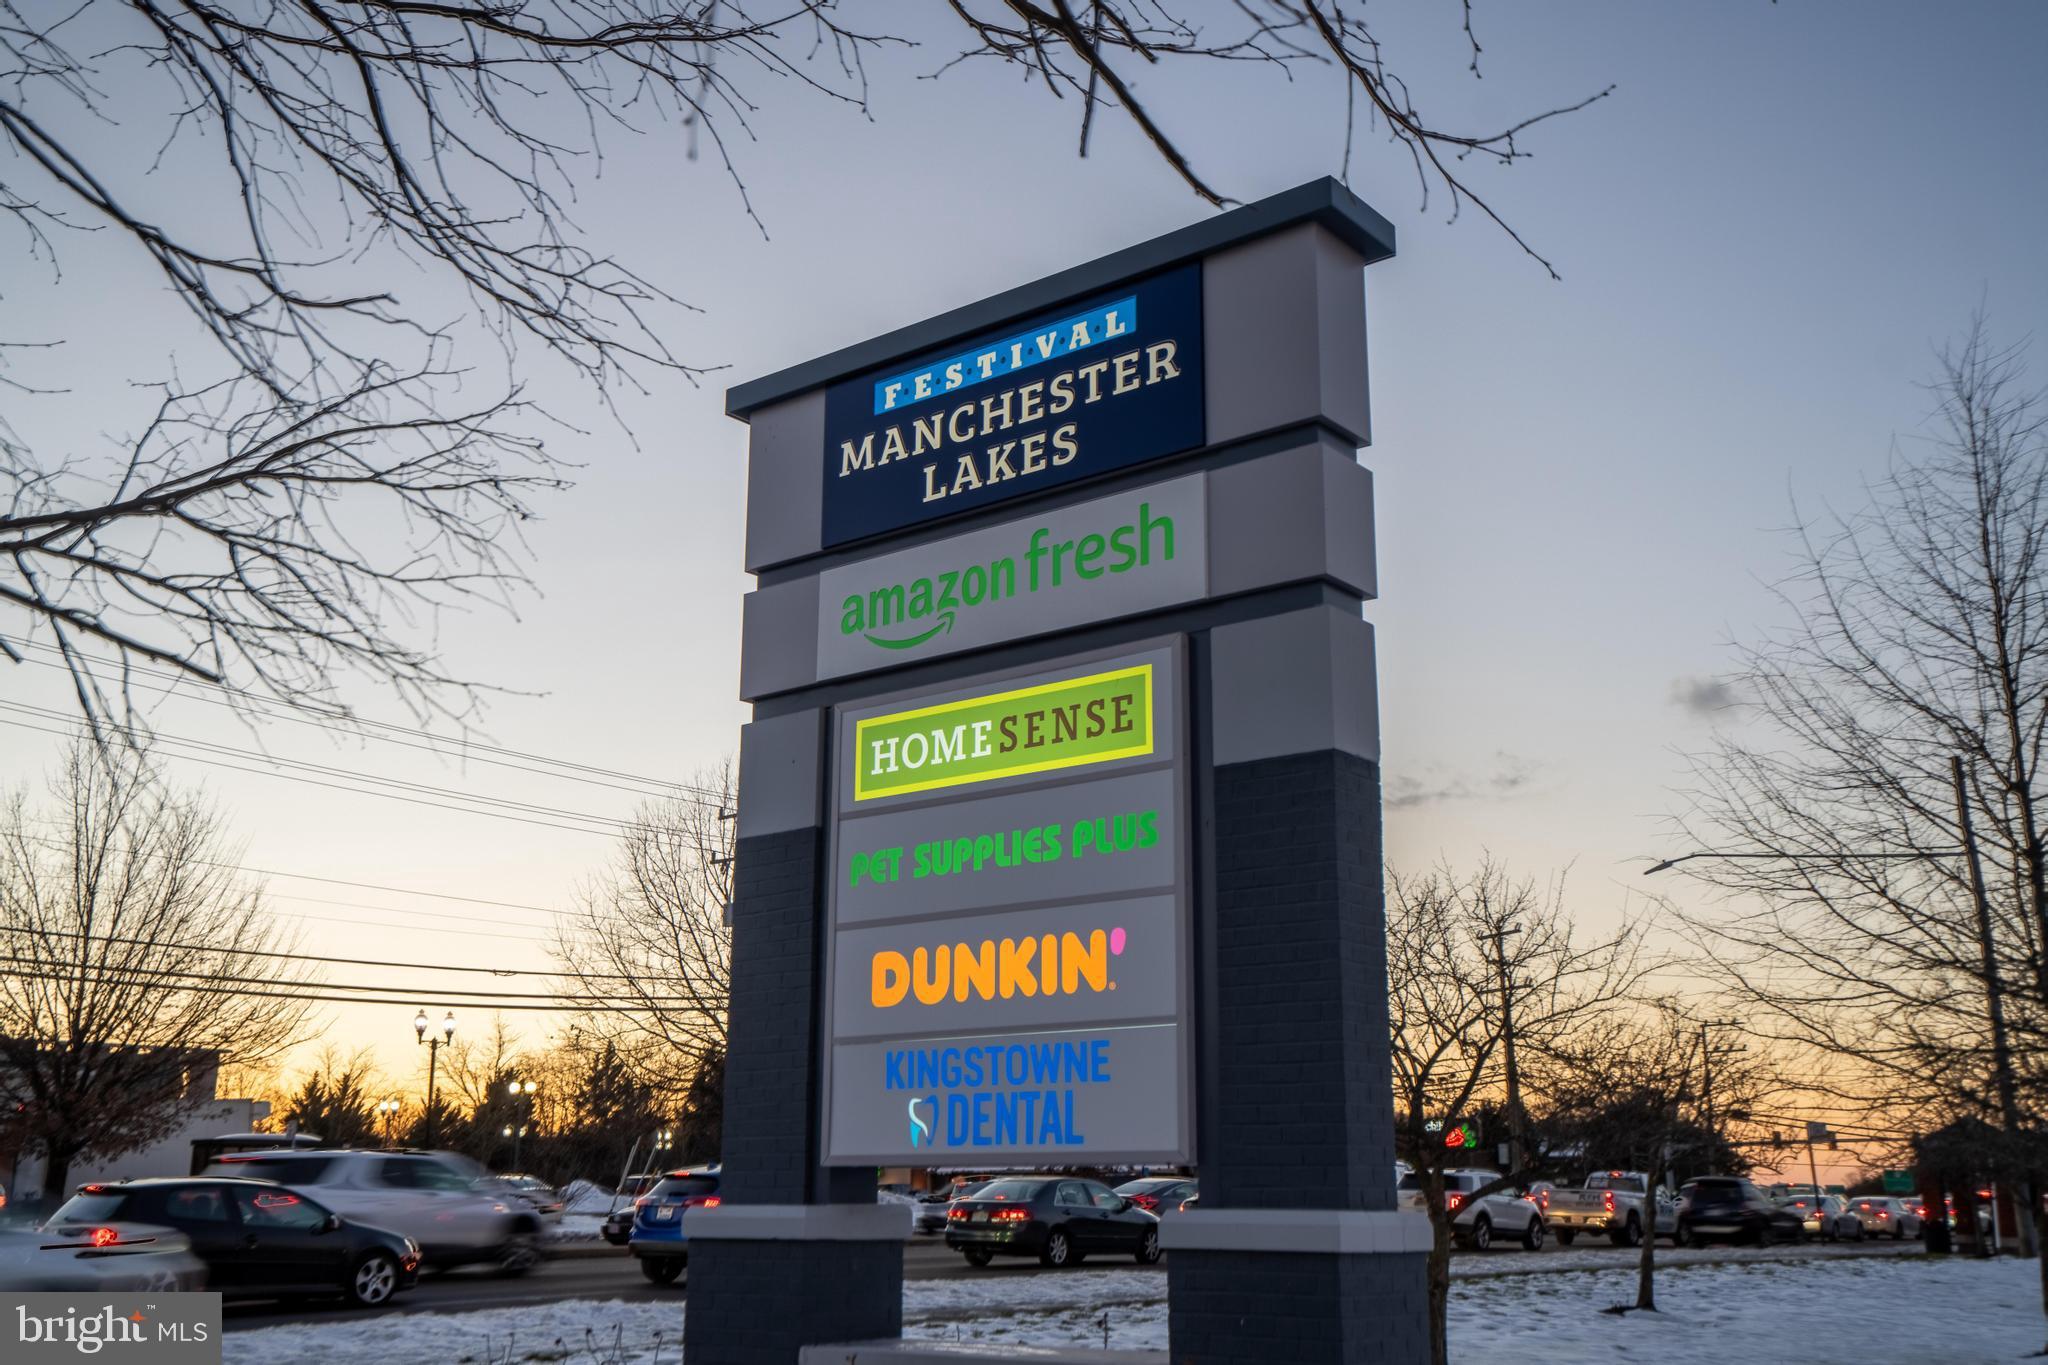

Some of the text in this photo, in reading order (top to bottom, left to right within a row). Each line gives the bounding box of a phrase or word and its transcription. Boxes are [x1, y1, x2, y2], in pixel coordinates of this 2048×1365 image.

[838, 339, 1182, 478] MANCHESTER
[922, 422, 1080, 503] LAKES
[840, 502, 1175, 635] amazon fresh
[850, 809, 1160, 887] PET SUPPLIES PLUS
[885, 1039, 1111, 1090] KINGSTOWNE
[947, 1089, 1084, 1147] DENTAL
